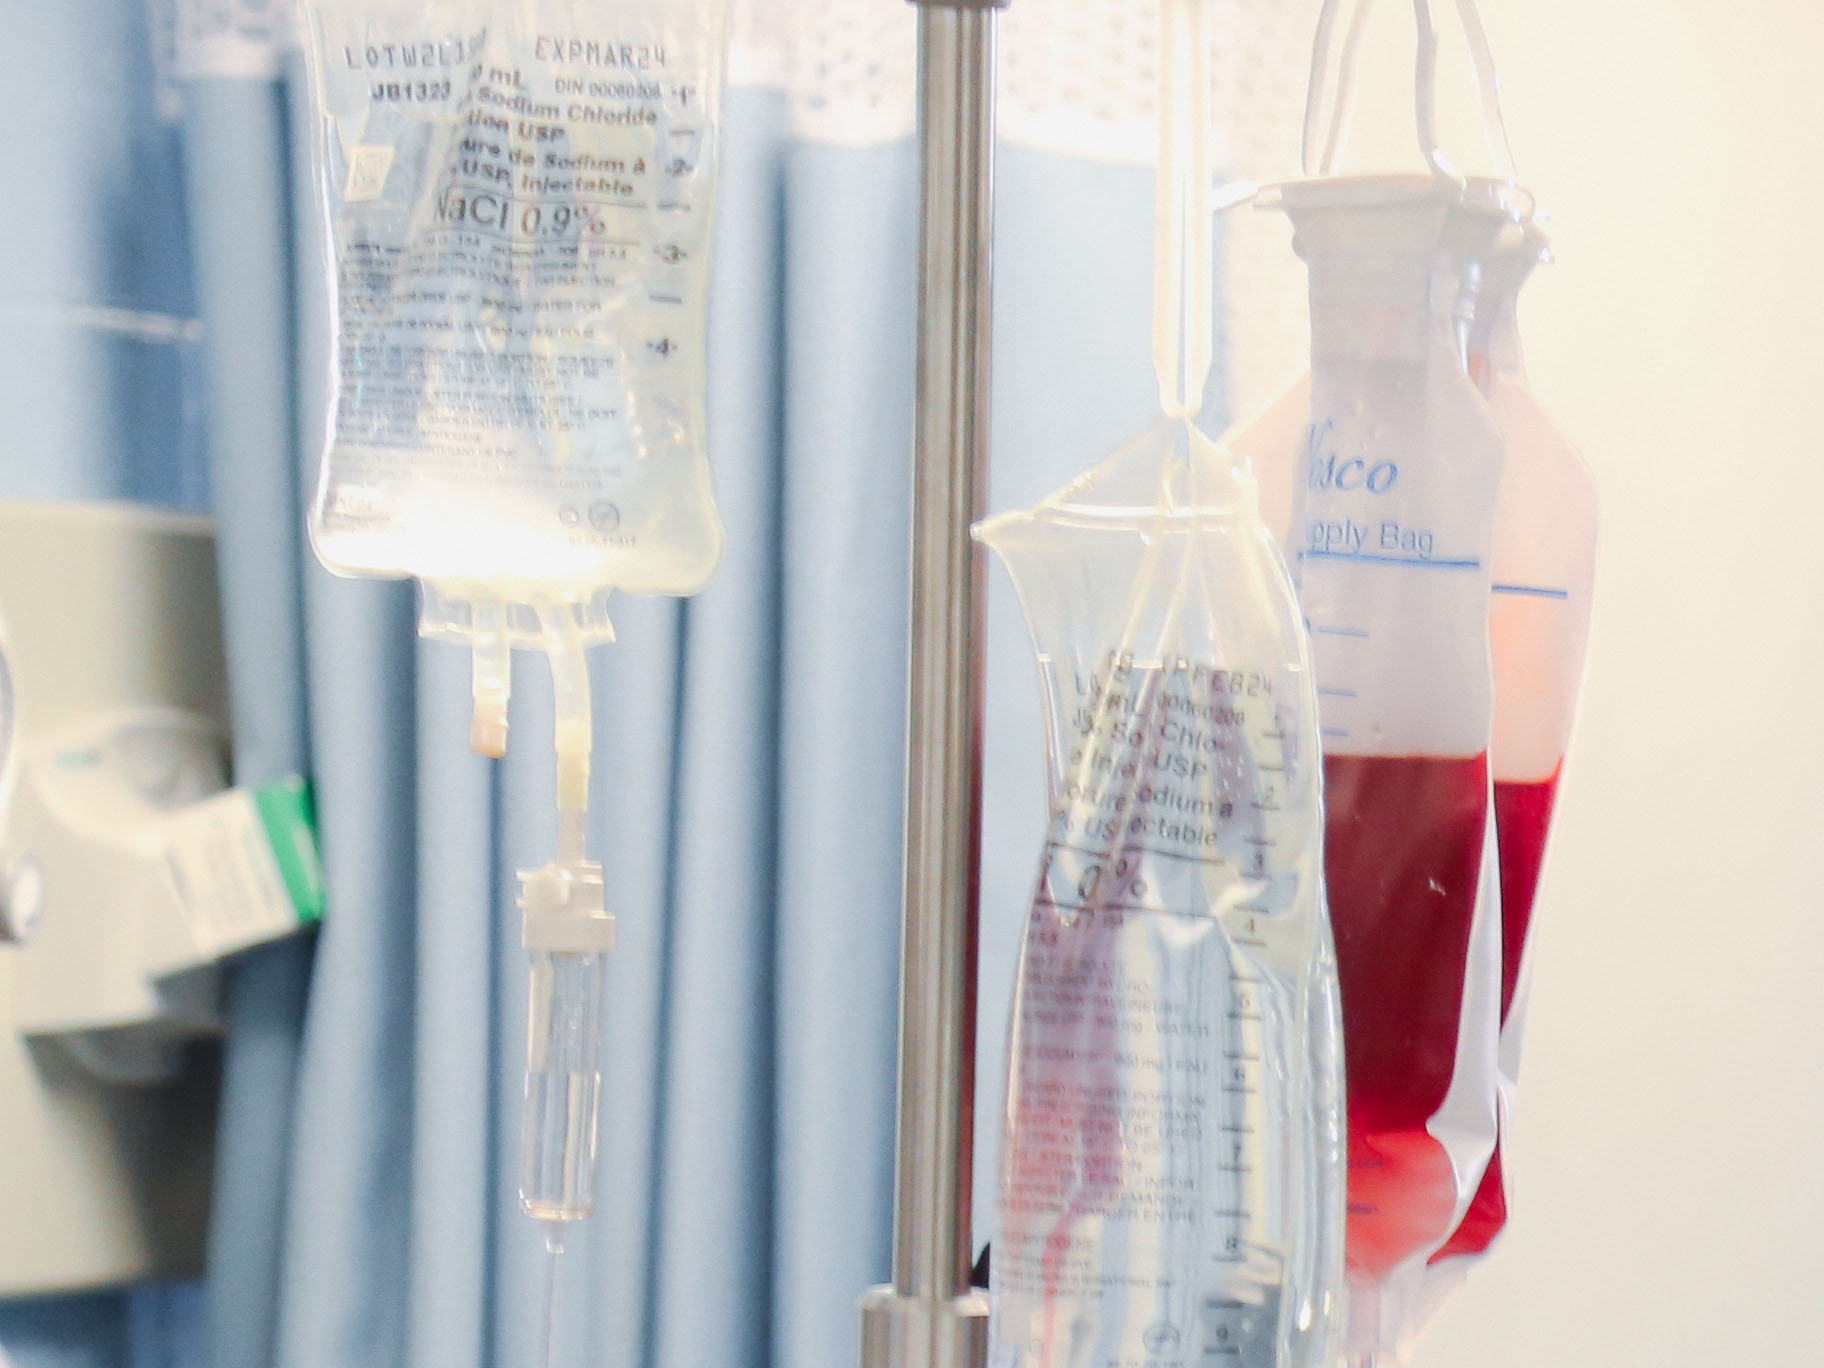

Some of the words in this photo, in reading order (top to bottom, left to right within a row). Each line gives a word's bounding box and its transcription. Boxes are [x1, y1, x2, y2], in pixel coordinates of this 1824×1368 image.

[567, 103, 658, 125] Chloride
[518, 120, 566, 142] USP
[545, 153, 625, 174] Sodium
[521, 174, 635, 196] Injectable
[521, 204, 607, 237] 0.9%
[1380, 520, 1434, 560] Bag
